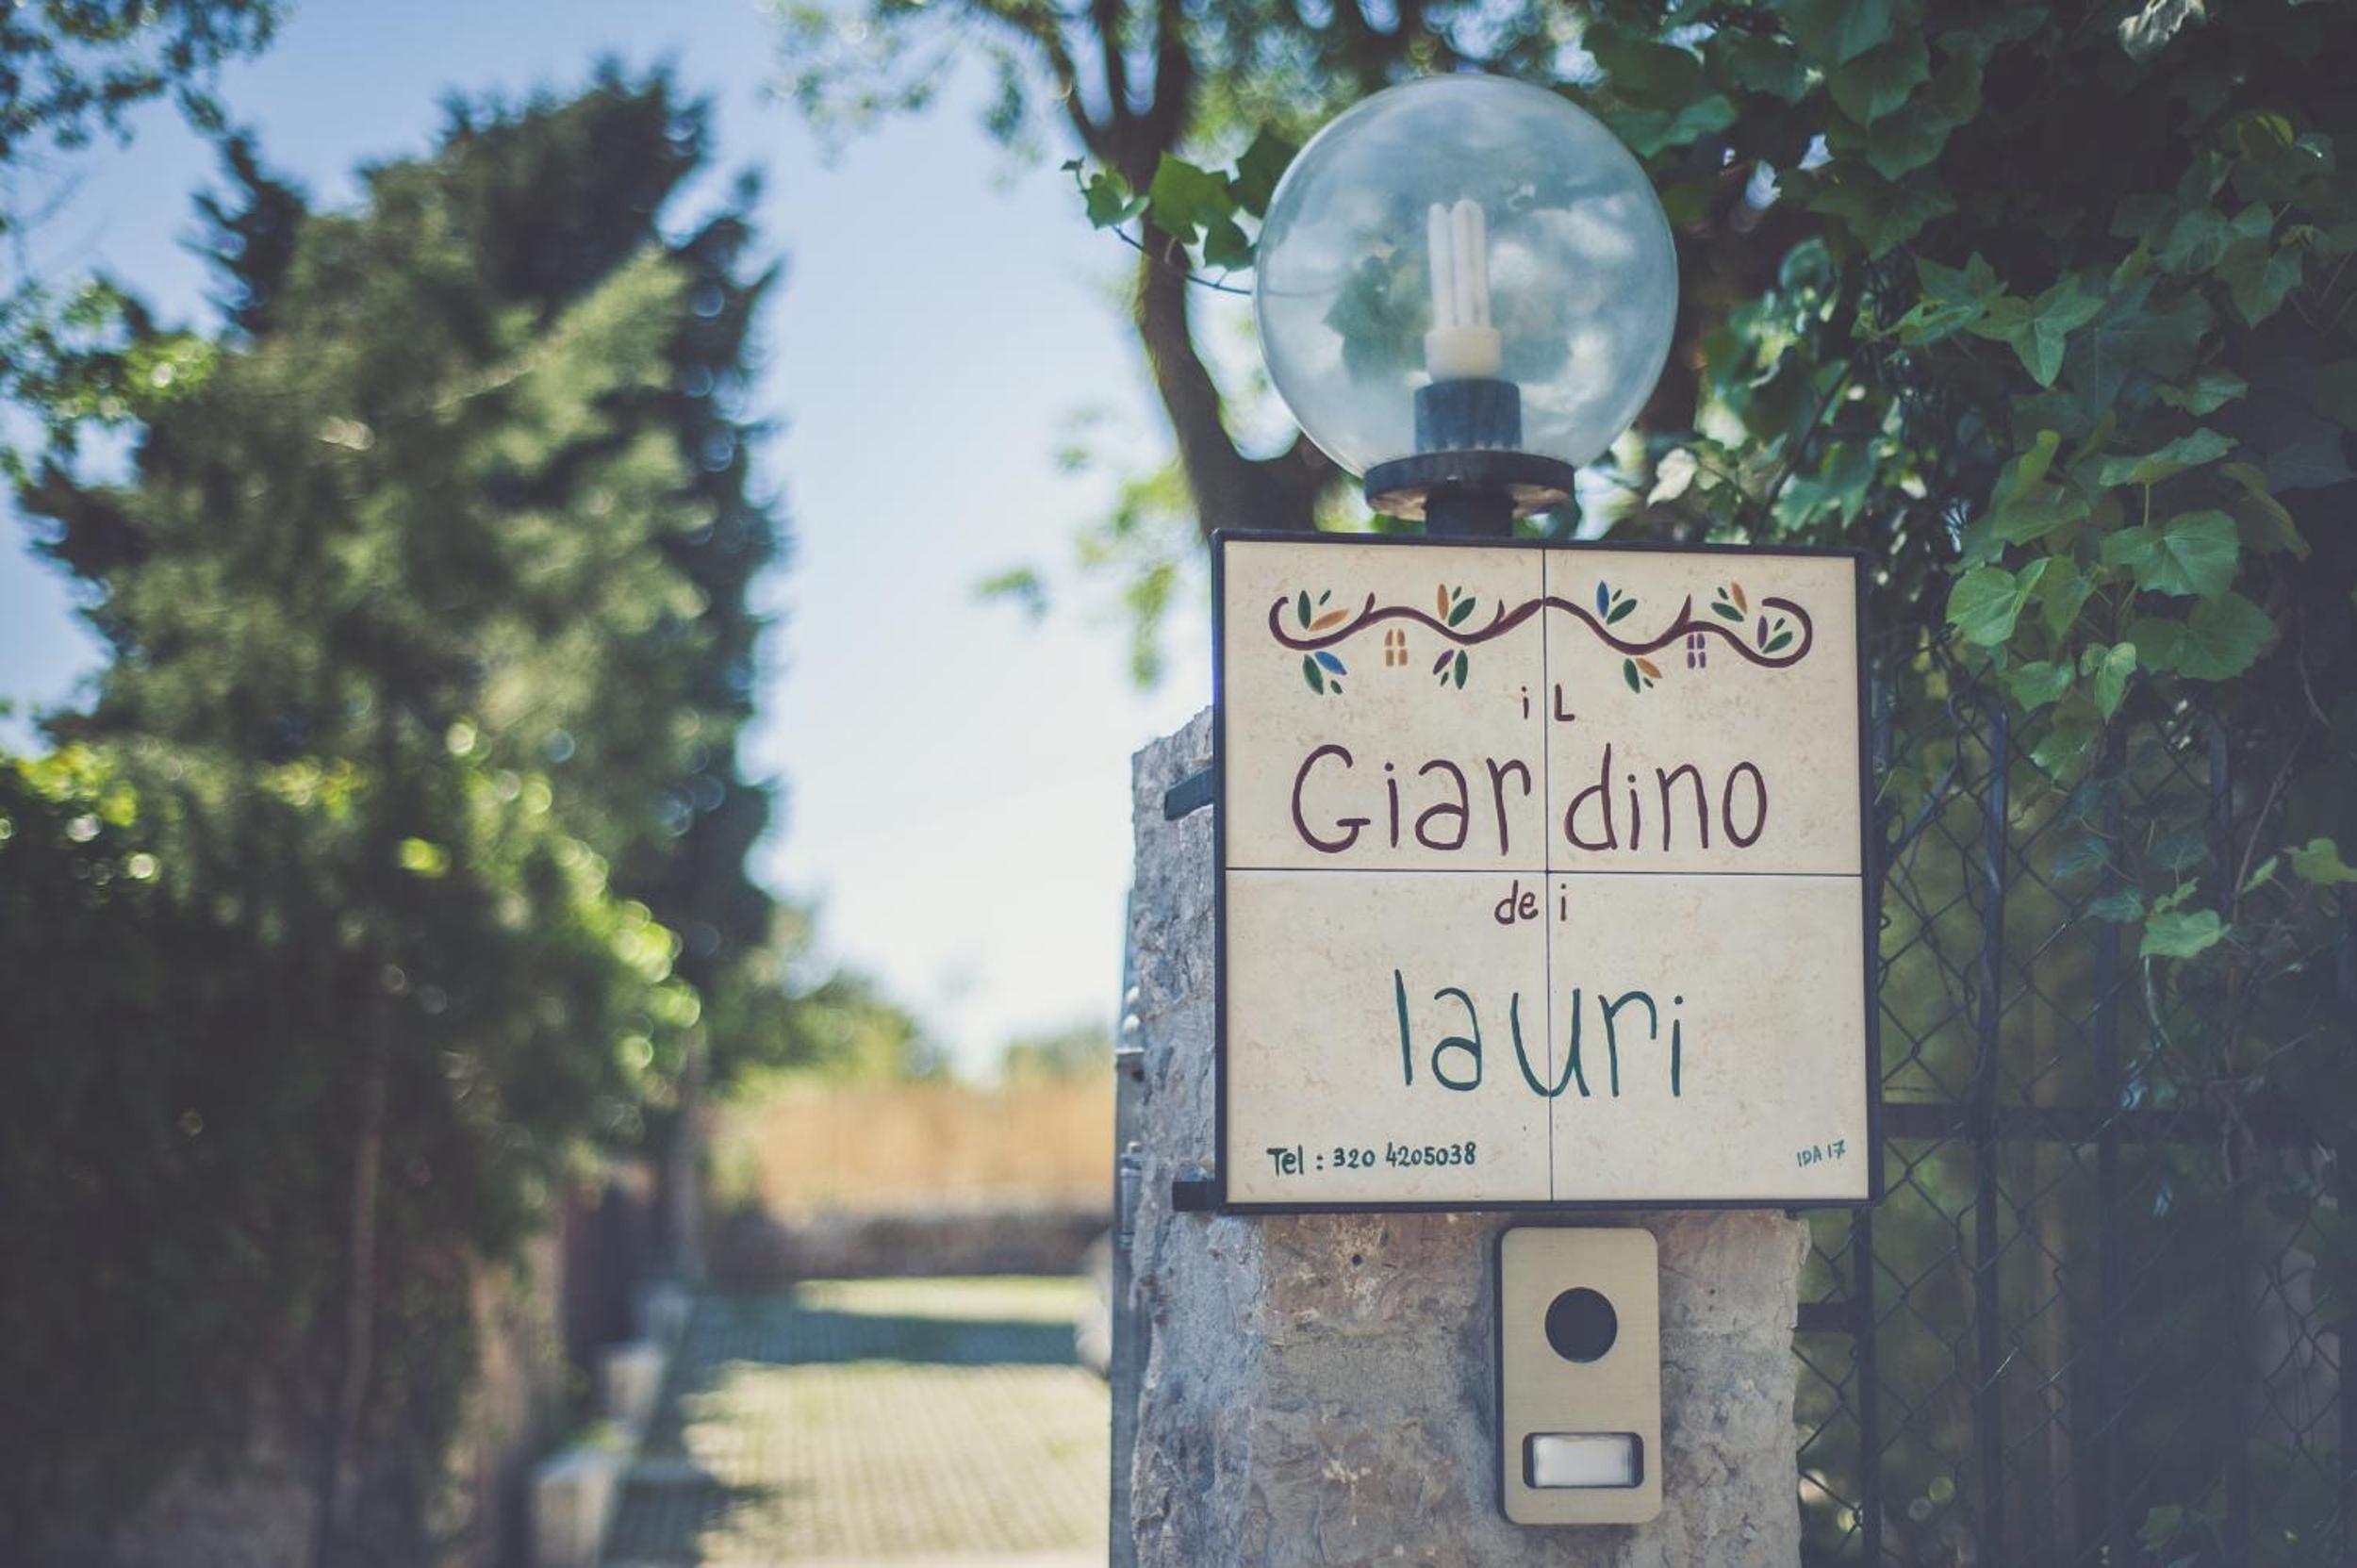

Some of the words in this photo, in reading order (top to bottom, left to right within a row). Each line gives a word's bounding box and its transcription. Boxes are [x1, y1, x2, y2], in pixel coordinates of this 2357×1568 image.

[1291, 742, 1768, 856] Giardino
[1393, 968, 1684, 1099] lauri
[1332, 1147, 1376, 1170] 320
[1385, 1141, 1476, 1168] 4205038
[1796, 1146, 1823, 1168] IDA
[1826, 1139, 1847, 1160] 17
